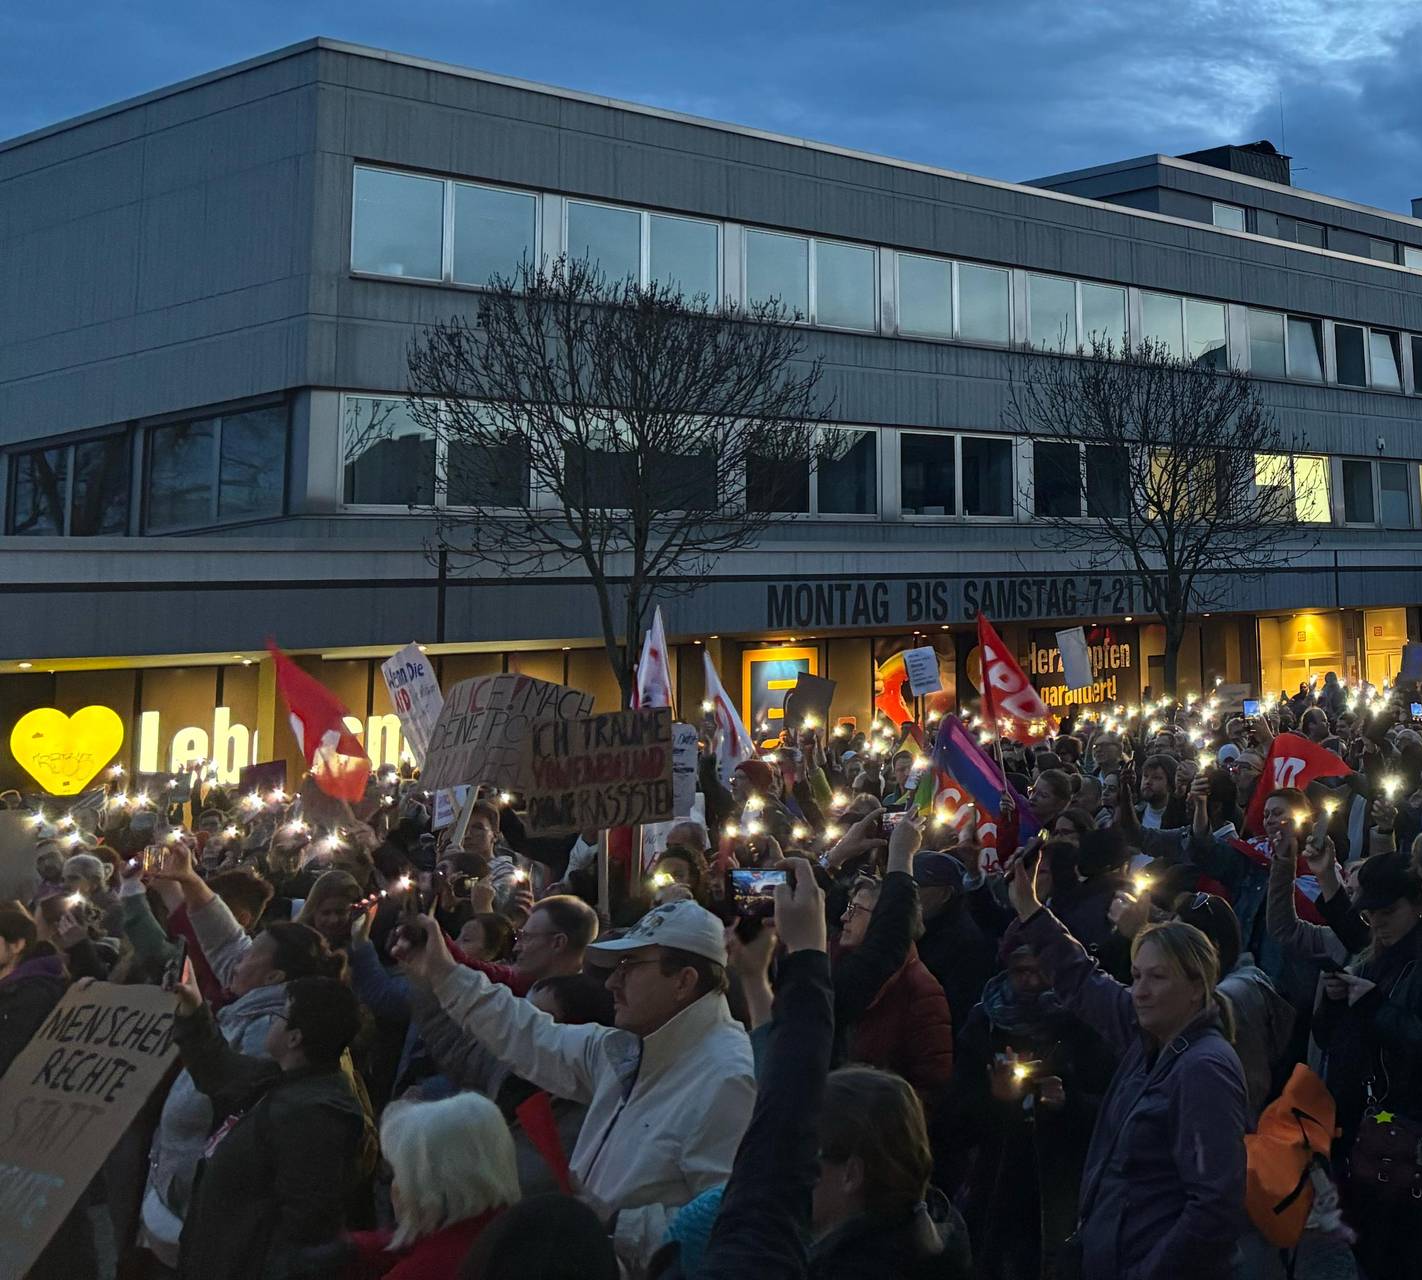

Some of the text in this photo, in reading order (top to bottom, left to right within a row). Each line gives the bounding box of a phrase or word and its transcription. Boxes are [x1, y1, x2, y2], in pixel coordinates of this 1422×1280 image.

[767, 582, 889, 627] MONTAG
[906, 581, 947, 622] BIS
[964, 577, 1077, 620] SAMSTAG
[405, 661, 425, 681] Die
[519, 680, 596, 720] MACH
[433, 712, 485, 750] DEINE
[531, 719, 569, 757] ICH
[38, 1004, 175, 1057] MENSCHEN
[32, 1048, 136, 1102] RECHTE
